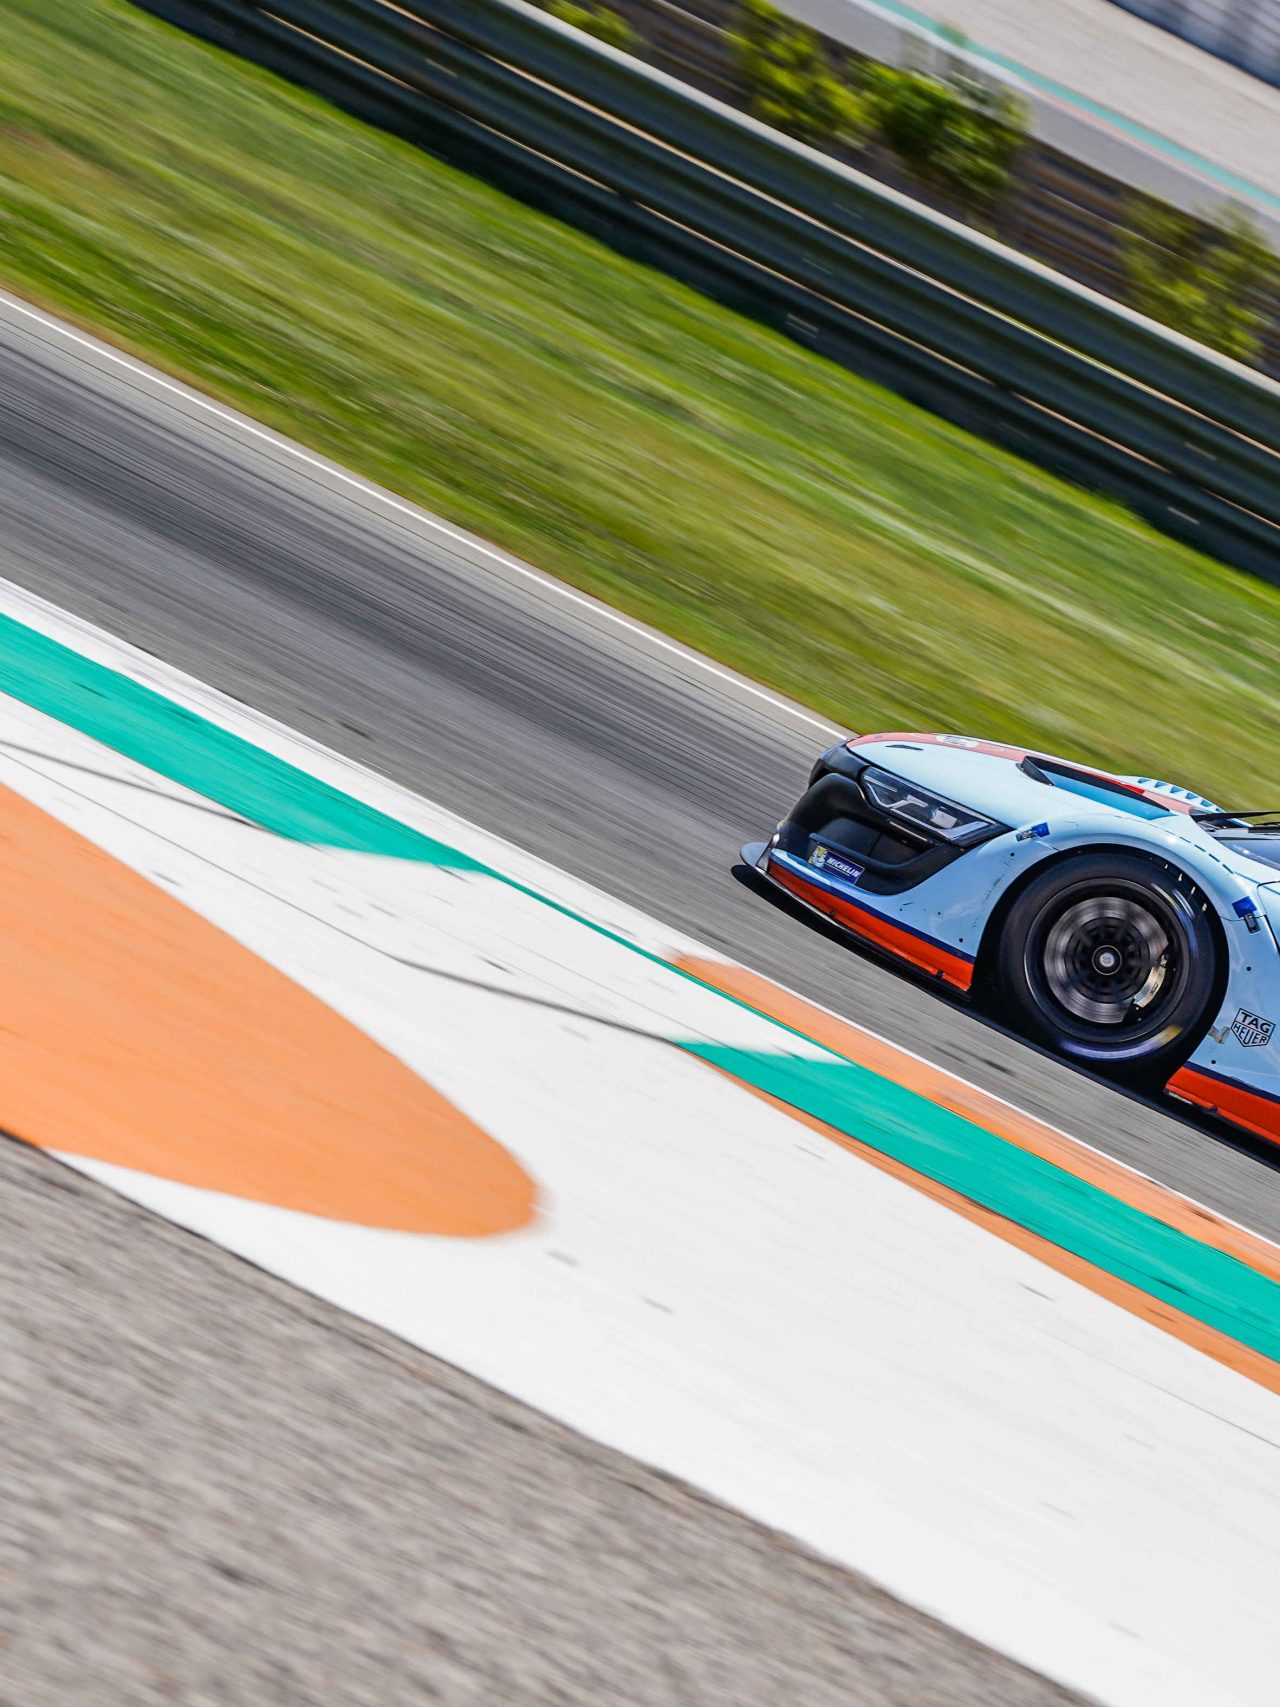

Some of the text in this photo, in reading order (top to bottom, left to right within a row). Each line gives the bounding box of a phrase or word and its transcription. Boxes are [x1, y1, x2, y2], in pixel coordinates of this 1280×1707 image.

[826, 857, 861, 877] MICHELIN
[1241, 1011, 1272, 1034] TAG
[1233, 1023, 1268, 1045] HEUER
